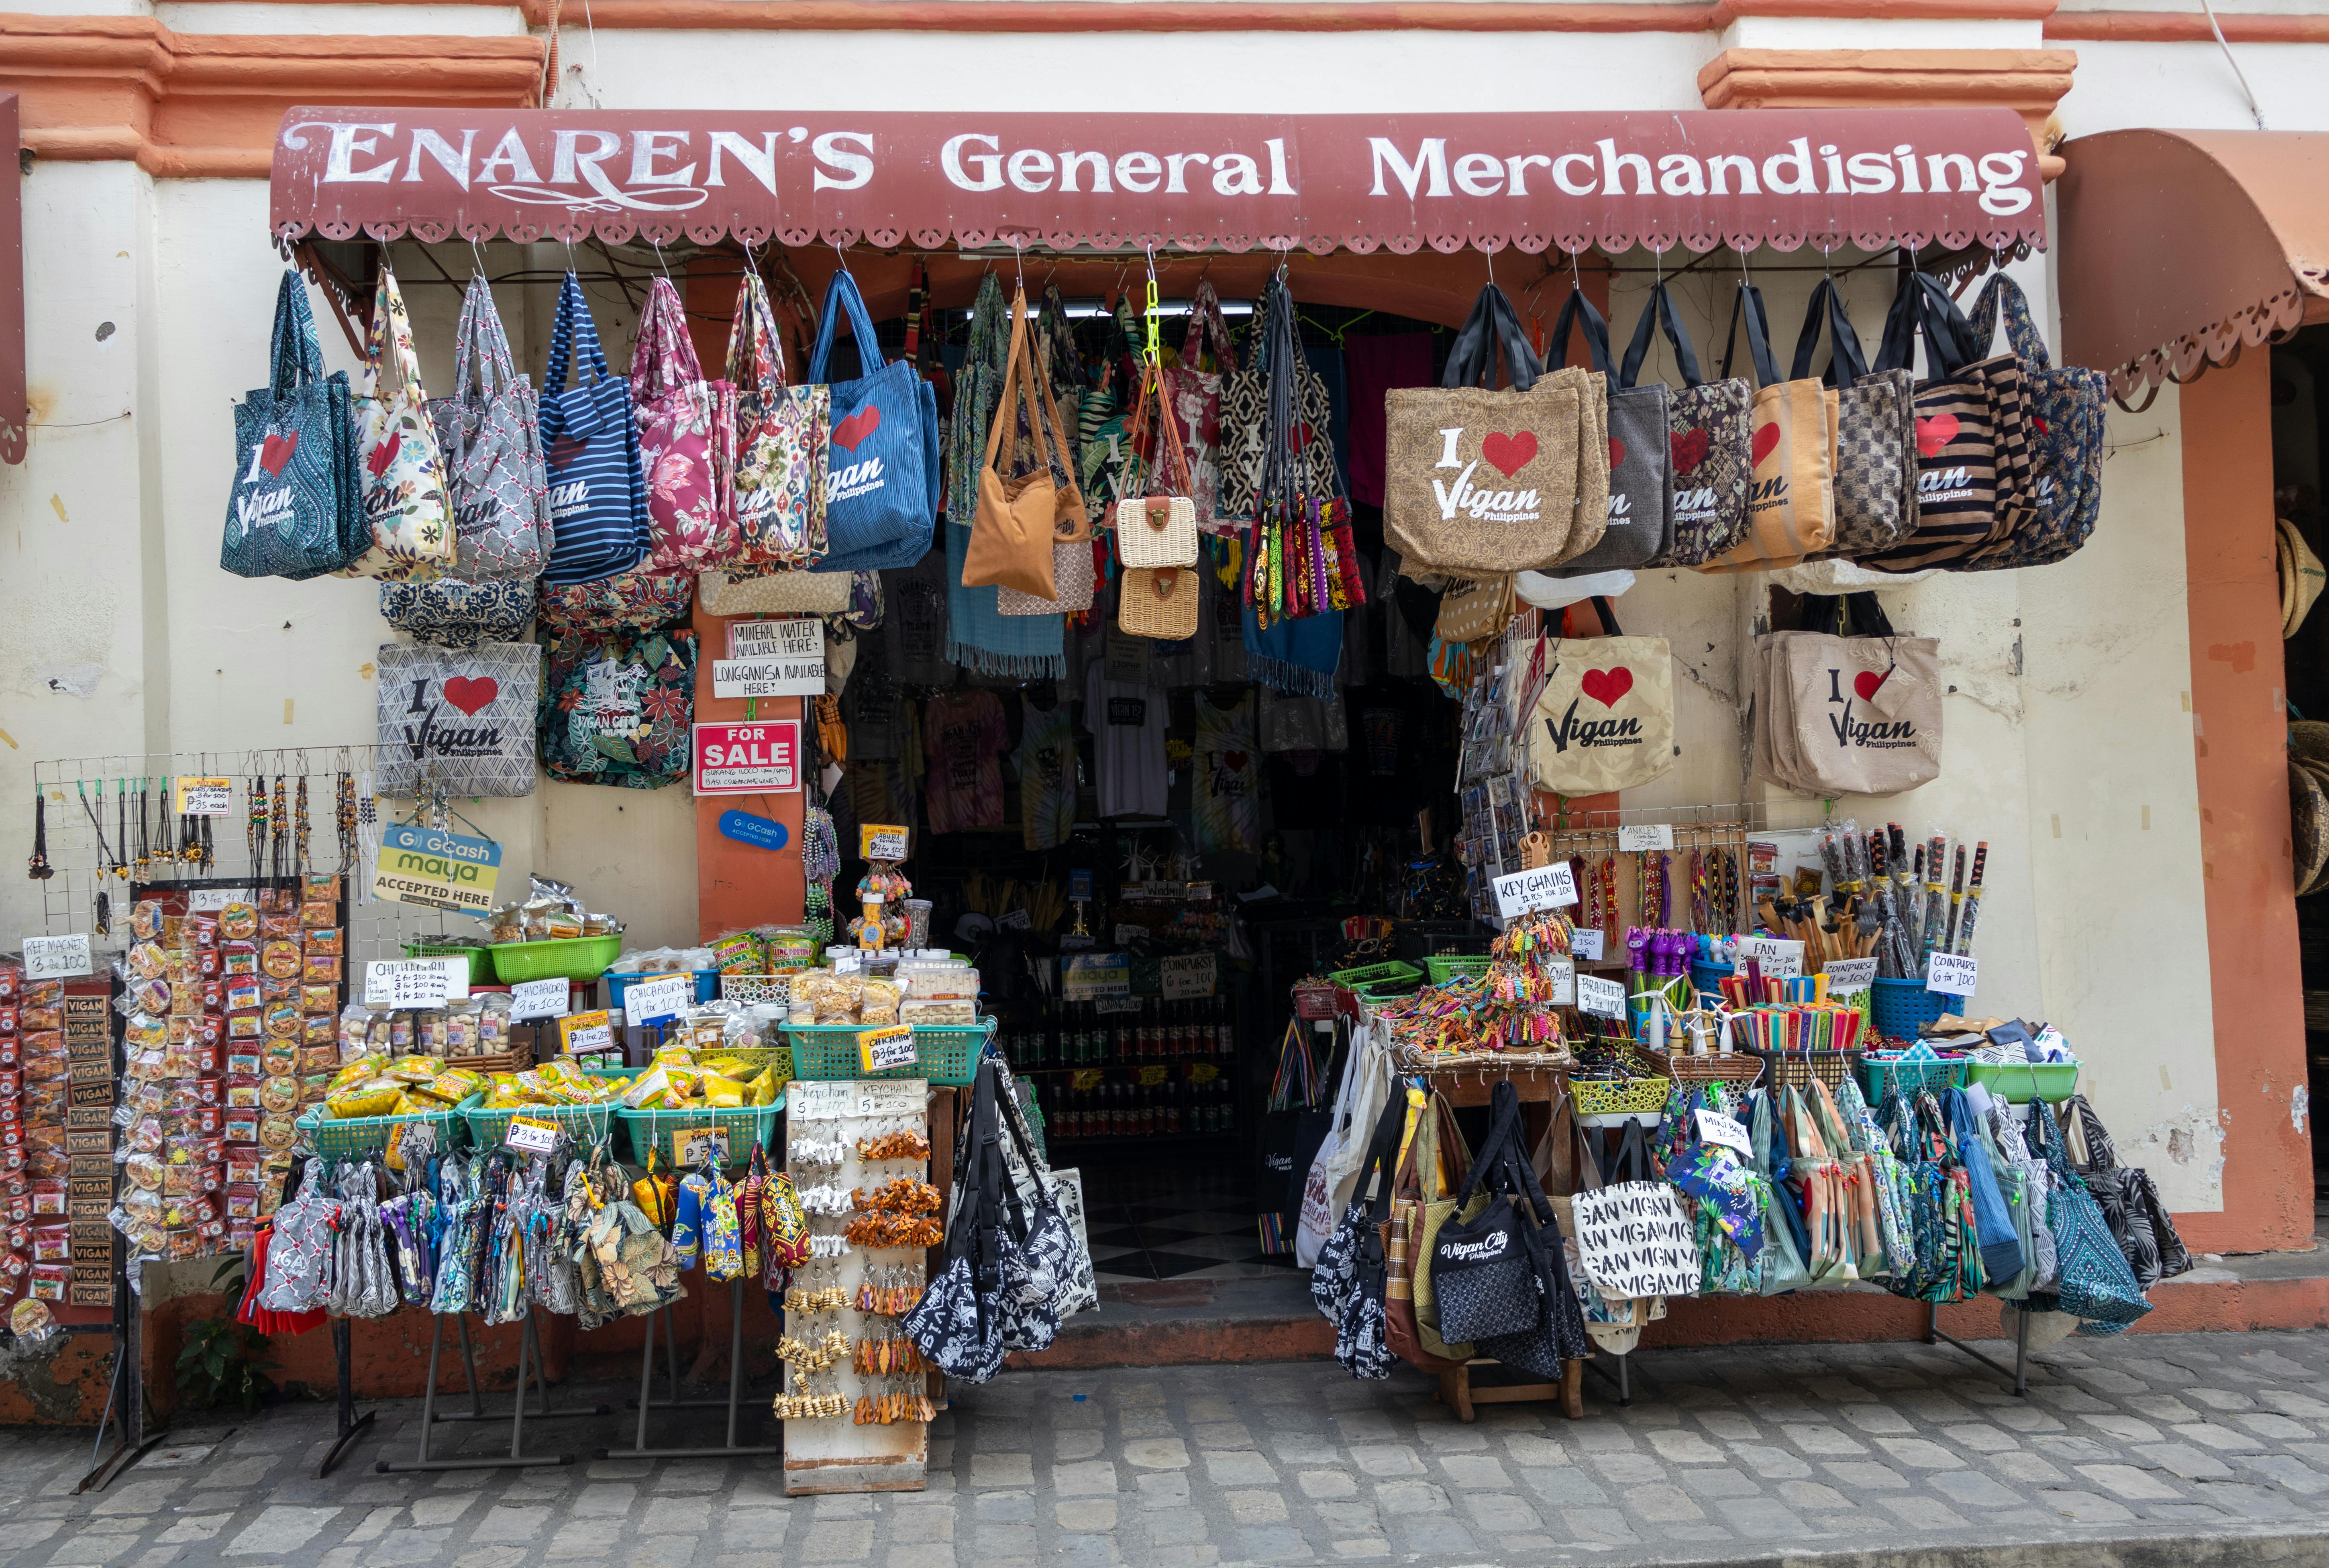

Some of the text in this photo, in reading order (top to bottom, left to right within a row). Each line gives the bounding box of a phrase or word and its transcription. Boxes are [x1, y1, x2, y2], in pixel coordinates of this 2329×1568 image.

[283, 121, 2033, 214] ENAREN'S General Merchandising
[1187, 418, 1199, 447] I
[1245, 424, 1263, 452] I
[1105, 433, 1124, 463] I
[1436, 427, 1463, 468] I
[836, 478, 884, 504] Philippines
[1432, 459, 1541, 520] Vigan
[237, 485, 295, 537] Vigan
[1484, 511, 1539, 522] Philippines
[261, 509, 294, 528] Philippines
[1451, 586, 1477, 600] Philippines
[735, 621, 815, 642] MINERAL WATER
[736, 641, 779, 657] AVAILABLE
[1112, 661, 1141, 670] 130PHP
[715, 664, 824, 682] LONGGANISA AVAILABLE
[1827, 669, 1845, 703] I
[407, 679, 430, 714] I
[578, 715, 637, 728] VIGAN CITY
[1545, 697, 1642, 753] Vigan
[1829, 698, 1916, 747] Vigan
[404, 703, 503, 761] Vigan
[728, 728, 765, 741] FOR
[1593, 736, 1642, 747] Philippines
[1866, 739, 1917, 749] Philippines
[451, 748, 503, 757] Philippines
[705, 743, 789, 766] SALE
[706, 768, 736, 776] SUKANG
[732, 829, 758, 840] ACCEPTED
[747, 822, 777, 838] GCash
[1627, 826, 1660, 835] ANKLETS
[427, 837, 489, 860] GCash
[398, 854, 479, 883] maya
[376, 877, 489, 905] ACCEPTED HERE
[1146, 883, 1184, 897] Windmill
[1521, 895, 1529, 903] 12
[1559, 887, 1572, 895] 100
[27, 938, 88, 955] REF MAGNETS
[1754, 943, 1776, 955] FAN
[32, 954, 87, 972] 3 100
[735, 960, 757, 970] Chips
[774, 959, 809, 969] BANANA
[1164, 956, 1215, 972] COINPURSE
[1782, 965, 1797, 975] 150
[1827, 961, 1874, 973] COINPURSE
[1073, 969, 1118, 983] maya
[1167, 972, 1214, 987] 6 100
[1828, 972, 1872, 985] 4 100
[1933, 970, 1975, 986] 6 100
[516, 980, 568, 998] CHICHACORN
[1064, 985, 1104, 994] ACCEPTED
[1581, 978, 1625, 999] BRACELETS
[395, 992, 400, 1001] 4
[68, 1001, 102, 1011] VIGAN
[518, 997, 565, 1013] 3 for 100
[631, 996, 685, 1018] 4 for 100
[1583, 994, 1623, 1014] 3 100
[69, 1023, 103, 1034] VIGAN
[598, 1030, 610, 1040] 200
[869, 1032, 912, 1047] CHICHAPOP
[71, 1045, 105, 1055] VIGAN
[884, 1044, 914, 1058] for 100
[73, 1066, 108, 1079] VIGAN
[75, 1088, 110, 1101] VIGAN
[803, 1083, 848, 1105] Keychain
[864, 1083, 912, 1094] KEYCHAIN
[797, 1101, 845, 1113] 5 100
[862, 1099, 870, 1112] 5
[72, 1112, 106, 1123] VIGAN
[1705, 1116, 1744, 1138] MINI BAG
[71, 1138, 106, 1148] VIGAN
[521, 1130, 553, 1144] 3 for 100
[1716, 1129, 1741, 1143] 100
[75, 1160, 111, 1170] VIGAN
[1265, 1153, 1292, 1169] Vigan
[74, 1183, 109, 1193] VIGAN
[73, 1204, 107, 1215] VIGAN
[1621, 1197, 1672, 1217] VIGAN
[75, 1227, 109, 1237] VIGAN
[1441, 1230, 1508, 1260] Vigan City
[75, 1248, 110, 1259] VIGAN
[1468, 1249, 1502, 1261] Philippines
[75, 1269, 109, 1280] VIGAN
[75, 1290, 110, 1300] VIGAN
